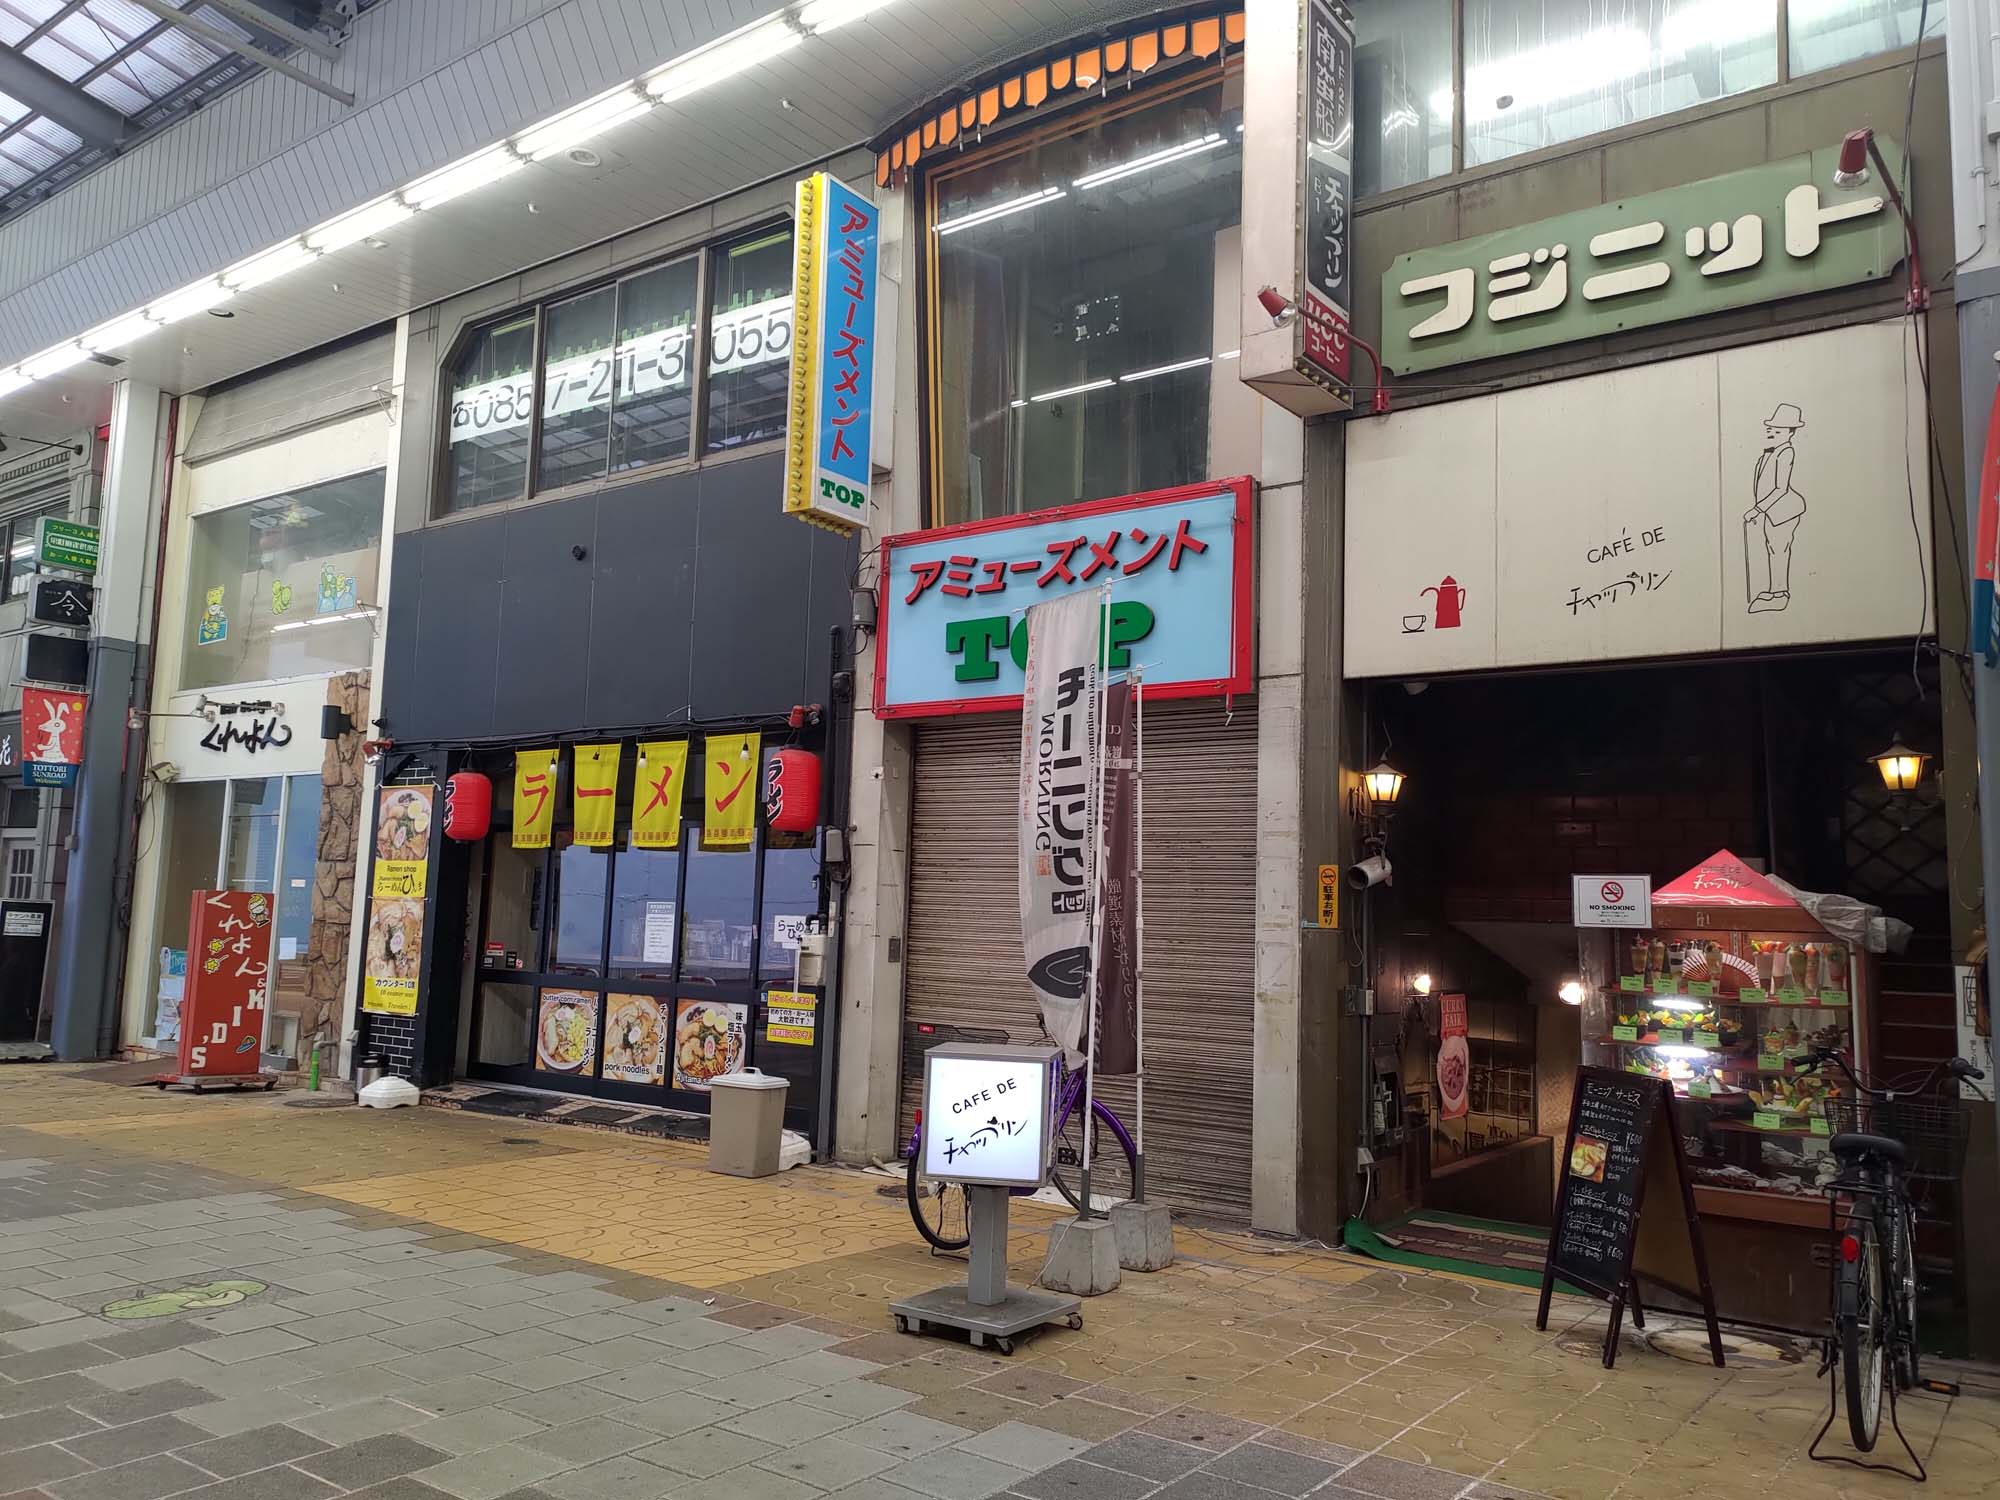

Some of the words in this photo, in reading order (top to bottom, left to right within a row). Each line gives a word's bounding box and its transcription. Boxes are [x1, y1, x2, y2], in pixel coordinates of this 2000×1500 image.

[1400, 184, 1884, 340] フジニット
[832, 202, 869, 462] アミューズメント
[1307, 298, 1348, 350] UCC
[1311, 334, 1341, 364] コーヒー
[820, 477, 866, 509] TOP
[905, 519, 1208, 604] アミューズメント
[1586, 528, 1635, 565] CAFÉ
[1641, 526, 1665, 547] DE
[946, 600, 1154, 682] TP
[200, 717, 293, 754] くれよん
[32, 771, 67, 779] SUNROAD
[33, 764, 67, 772] TOTTORI
[521, 760, 753, 828] ラーメン
[1323, 885, 1335, 926] 駐車お断り
[206, 891, 268, 978] くれよん
[543, 993, 560, 1001] butter
[581, 1027, 591, 1067] ラーメン
[656, 1003, 668, 1075] チャーシュー麺
[604, 1063, 621, 1072] pork
[622, 1064, 650, 1075] noodles
[951, 1089, 992, 1115] CAFE
[996, 1078, 1018, 1097] DE
[1586, 1083, 1616, 1098] モーニング
[1616, 1088, 1641, 1106] サービス
